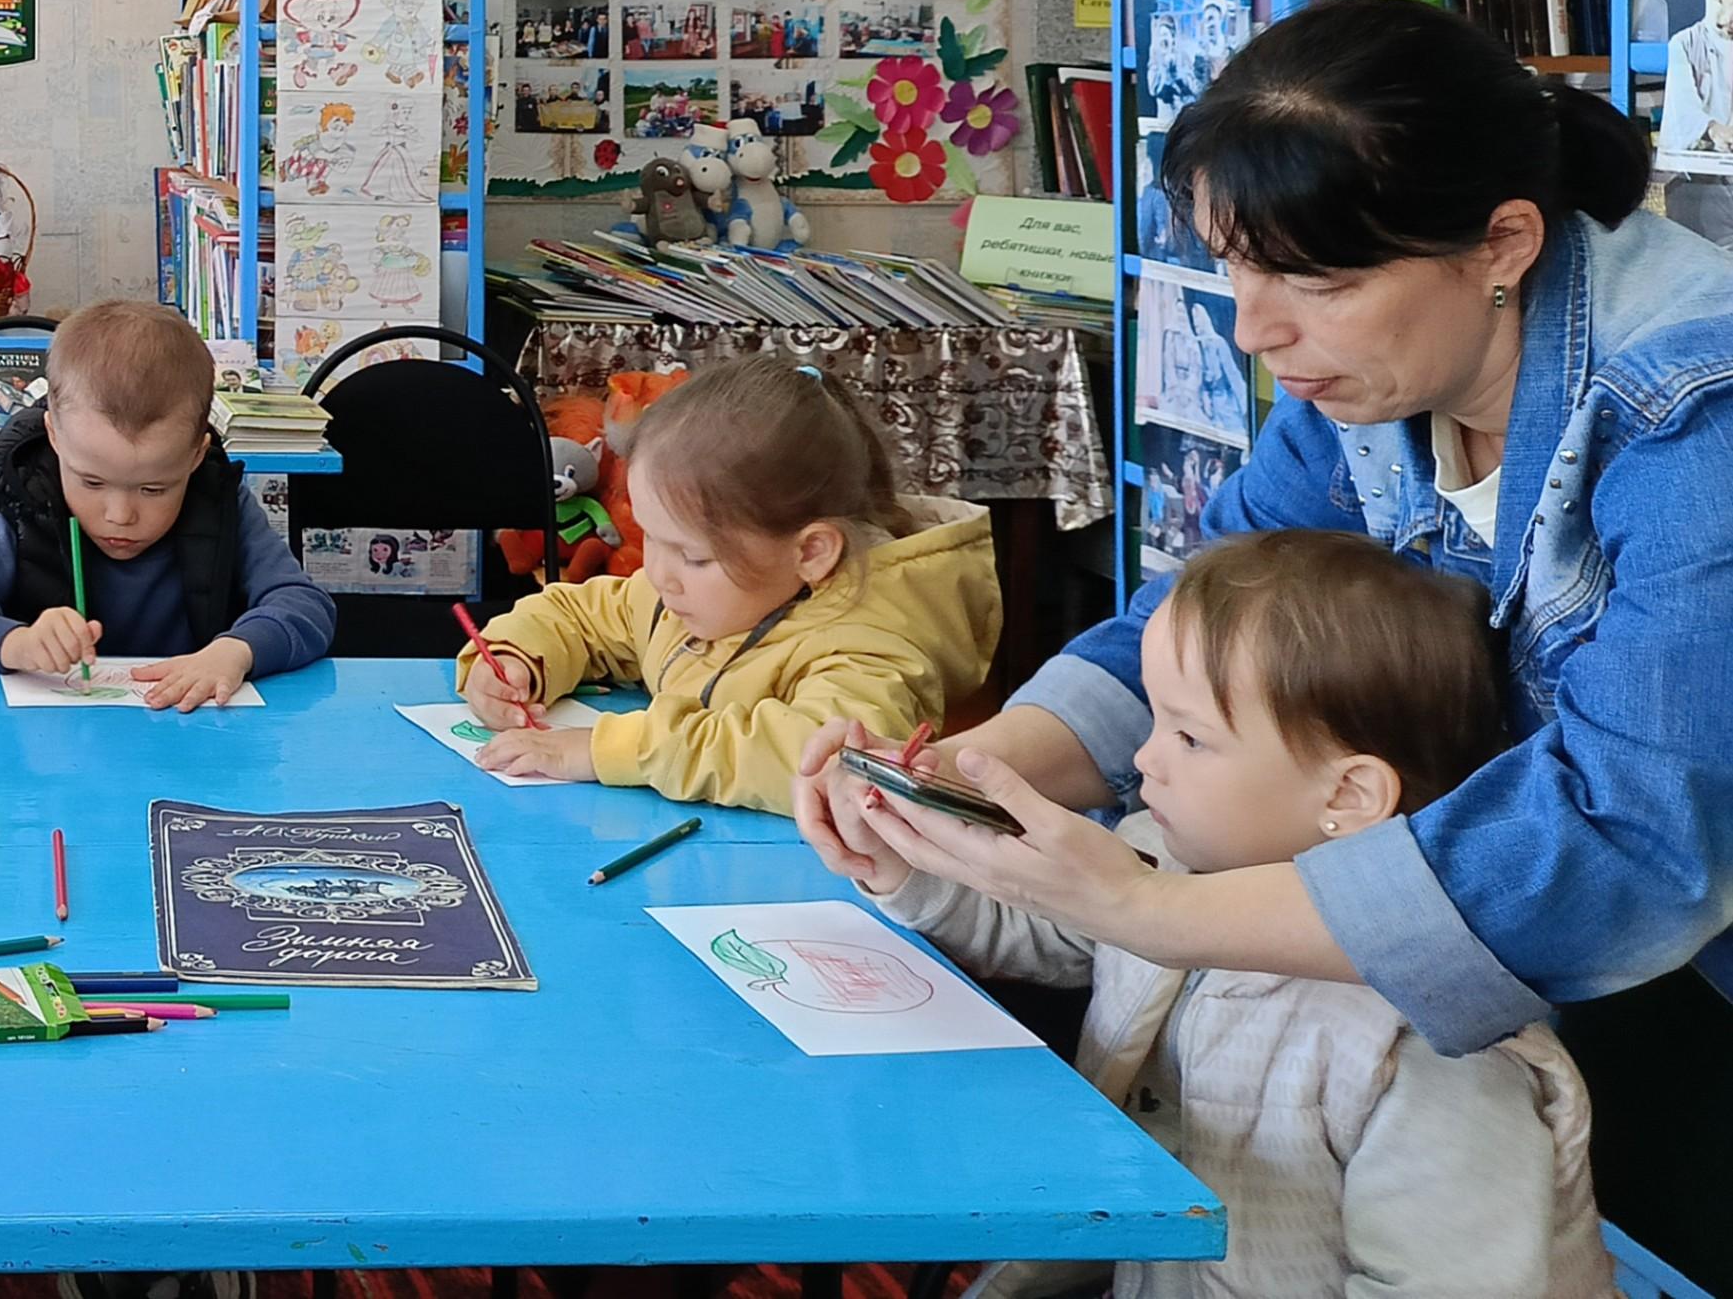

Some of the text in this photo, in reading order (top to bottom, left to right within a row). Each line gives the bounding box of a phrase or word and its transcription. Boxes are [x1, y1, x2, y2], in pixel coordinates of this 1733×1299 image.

[1019, 217, 1083, 236] Для вас,
[981, 238, 1115, 263] ребятишки, новые
[241, 924, 434, 952] Зимняя
[267, 948, 418, 969] дорога
